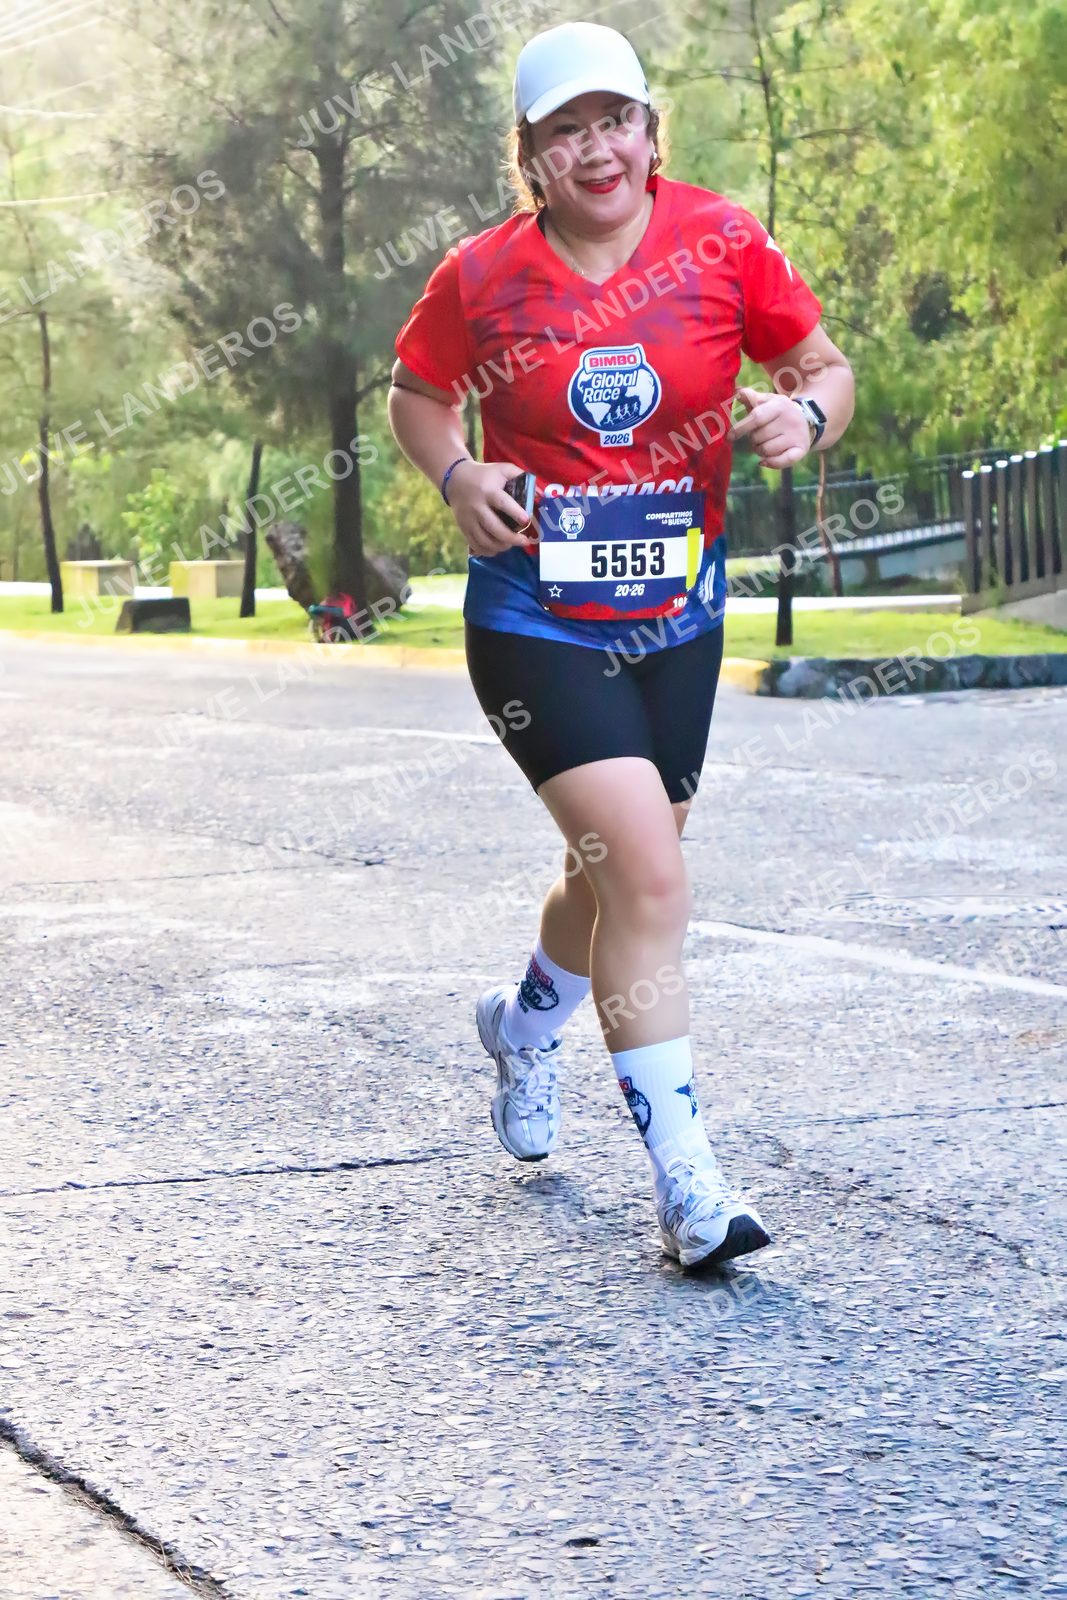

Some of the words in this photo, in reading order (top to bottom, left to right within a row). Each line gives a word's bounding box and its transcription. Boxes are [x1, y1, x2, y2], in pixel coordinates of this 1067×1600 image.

[589, 354, 637, 367] BIMBO
[591, 370, 637, 389] Global
[582, 387, 620, 403] Race
[603, 433, 630, 445] 2026
[645, 510, 693, 521] COMPARTIMOS
[668, 517, 693, 527] BUENO
[591, 541, 665, 578] 5553
